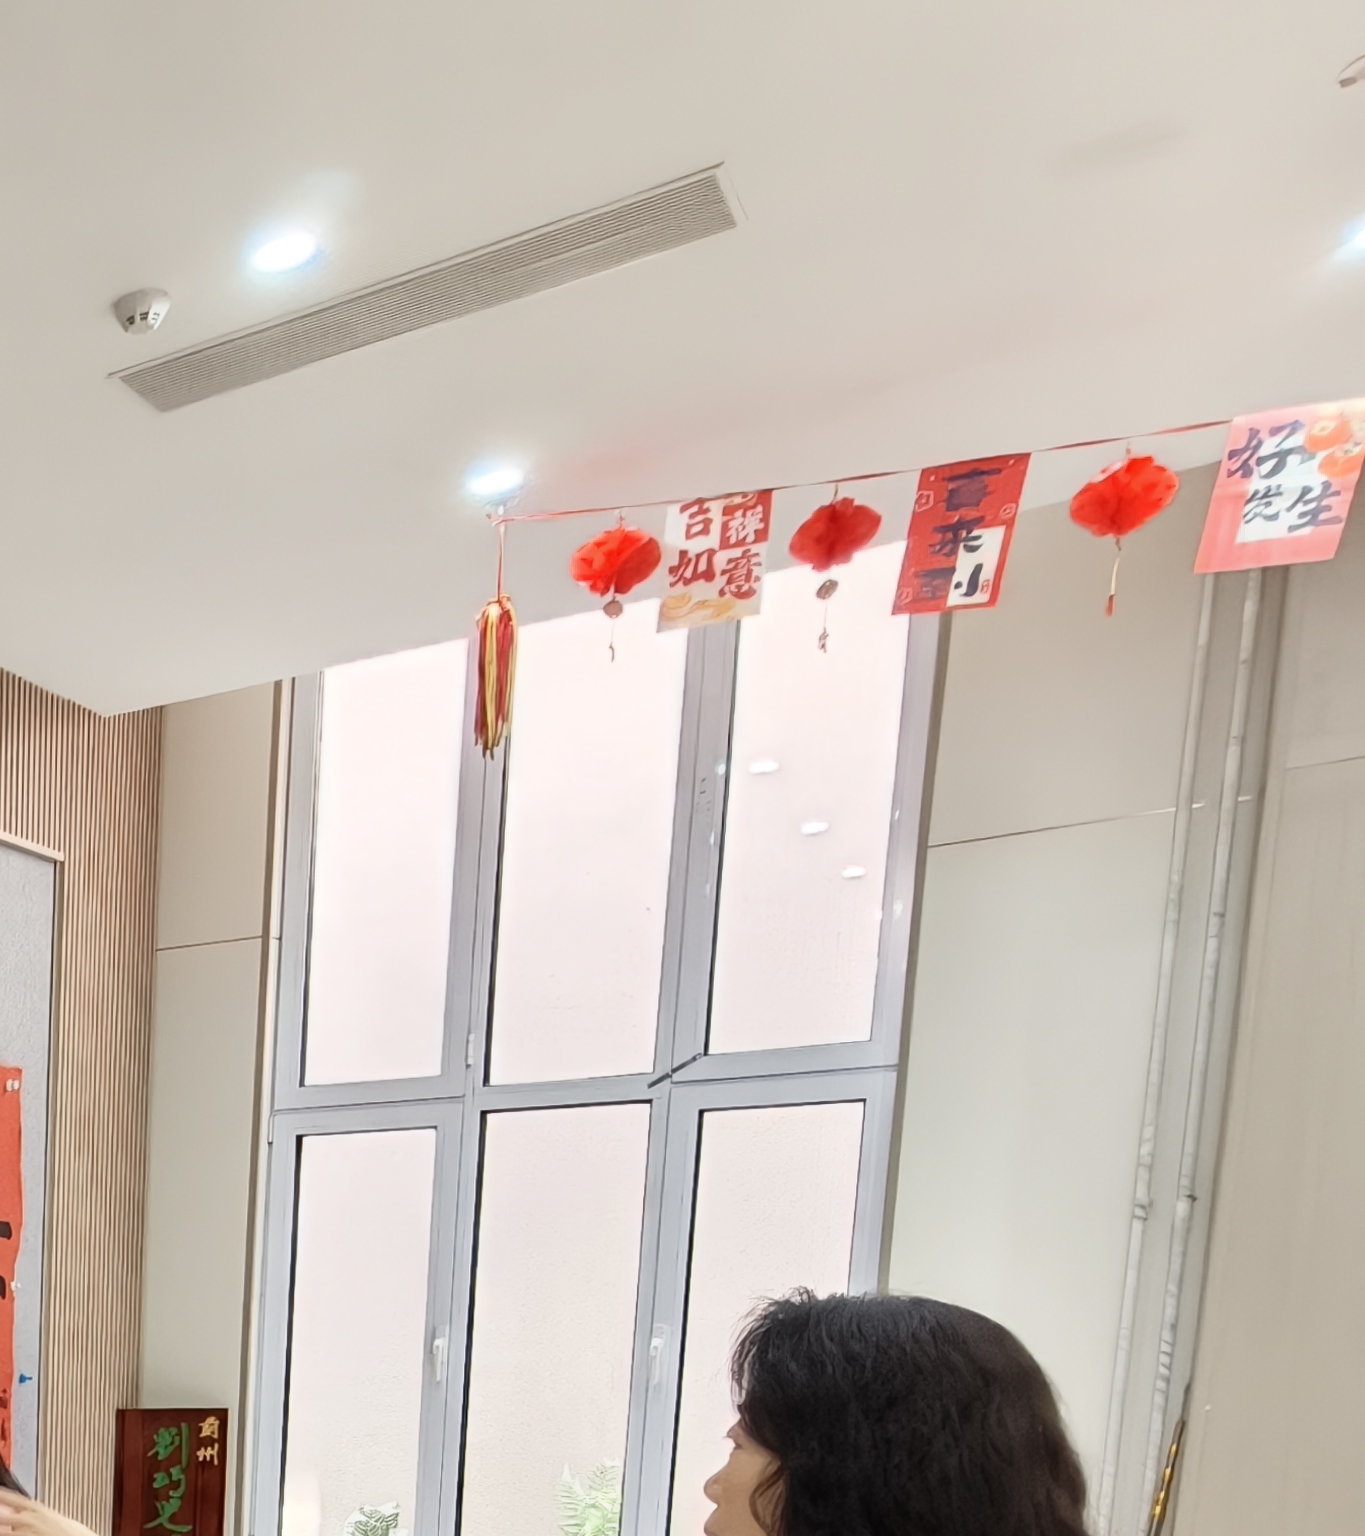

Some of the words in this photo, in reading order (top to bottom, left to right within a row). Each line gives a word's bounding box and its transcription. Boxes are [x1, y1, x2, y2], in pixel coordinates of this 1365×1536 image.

[1227, 419, 1317, 480] 好
[679, 497, 765, 545] 吉祥
[668, 548, 763, 600] 如意
